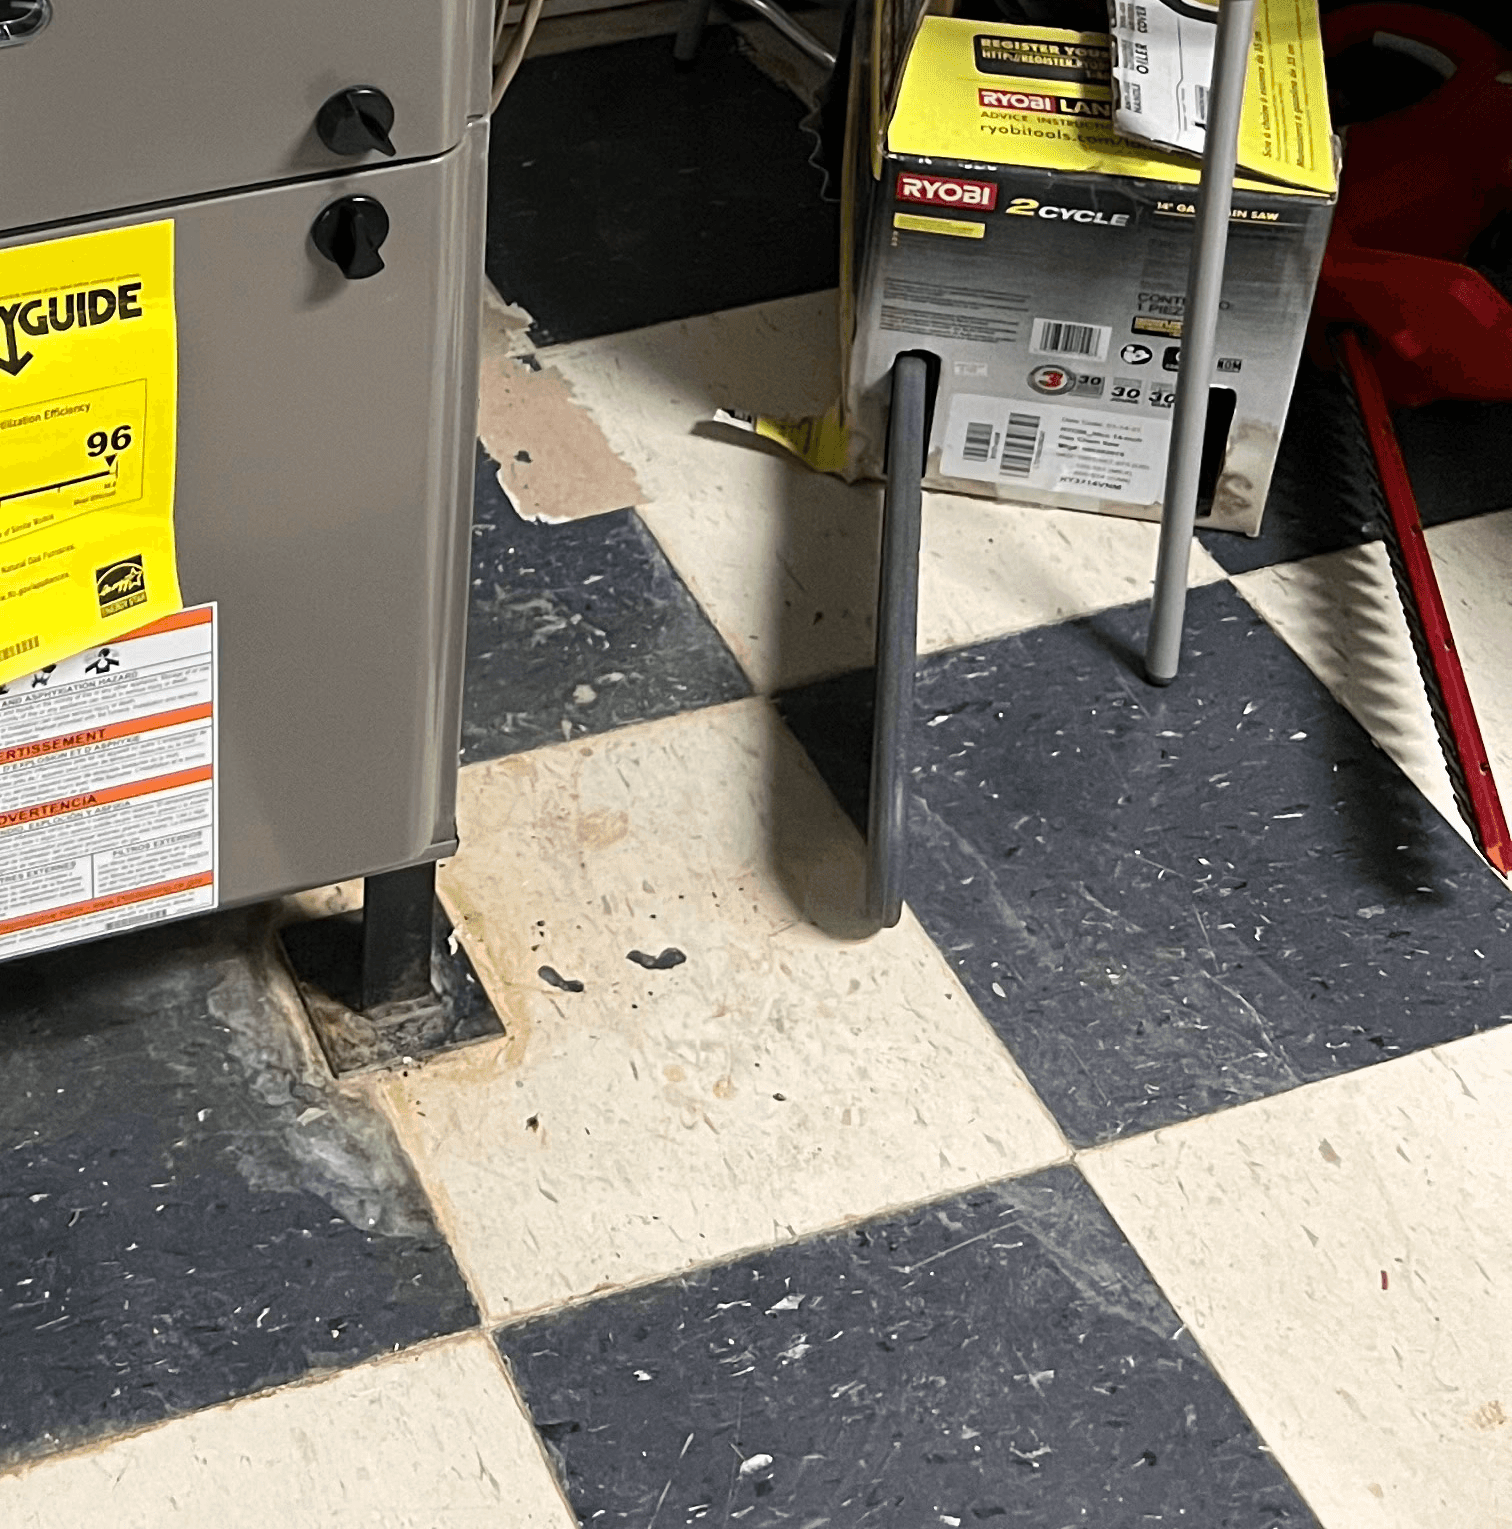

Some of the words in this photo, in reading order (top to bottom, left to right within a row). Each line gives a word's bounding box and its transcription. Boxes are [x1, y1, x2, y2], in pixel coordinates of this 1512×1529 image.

[980, 38, 1059, 55] REGISTER
[1134, 43, 1149, 75] OILER
[980, 90, 1052, 111] RYOBI
[902, 178, 991, 205] RYOBI
[1251, 211, 1279, 221] SAW
[1078, 374, 1102, 386] 30
[1110, 385, 1141, 399] 30
[44, 402, 91, 421] Efficiency
[86, 424, 132, 458] 96
[1, 696, 23, 709] AND
[98, 671, 139, 688] HAZARD
[112, 842, 151, 858] FILTROS
